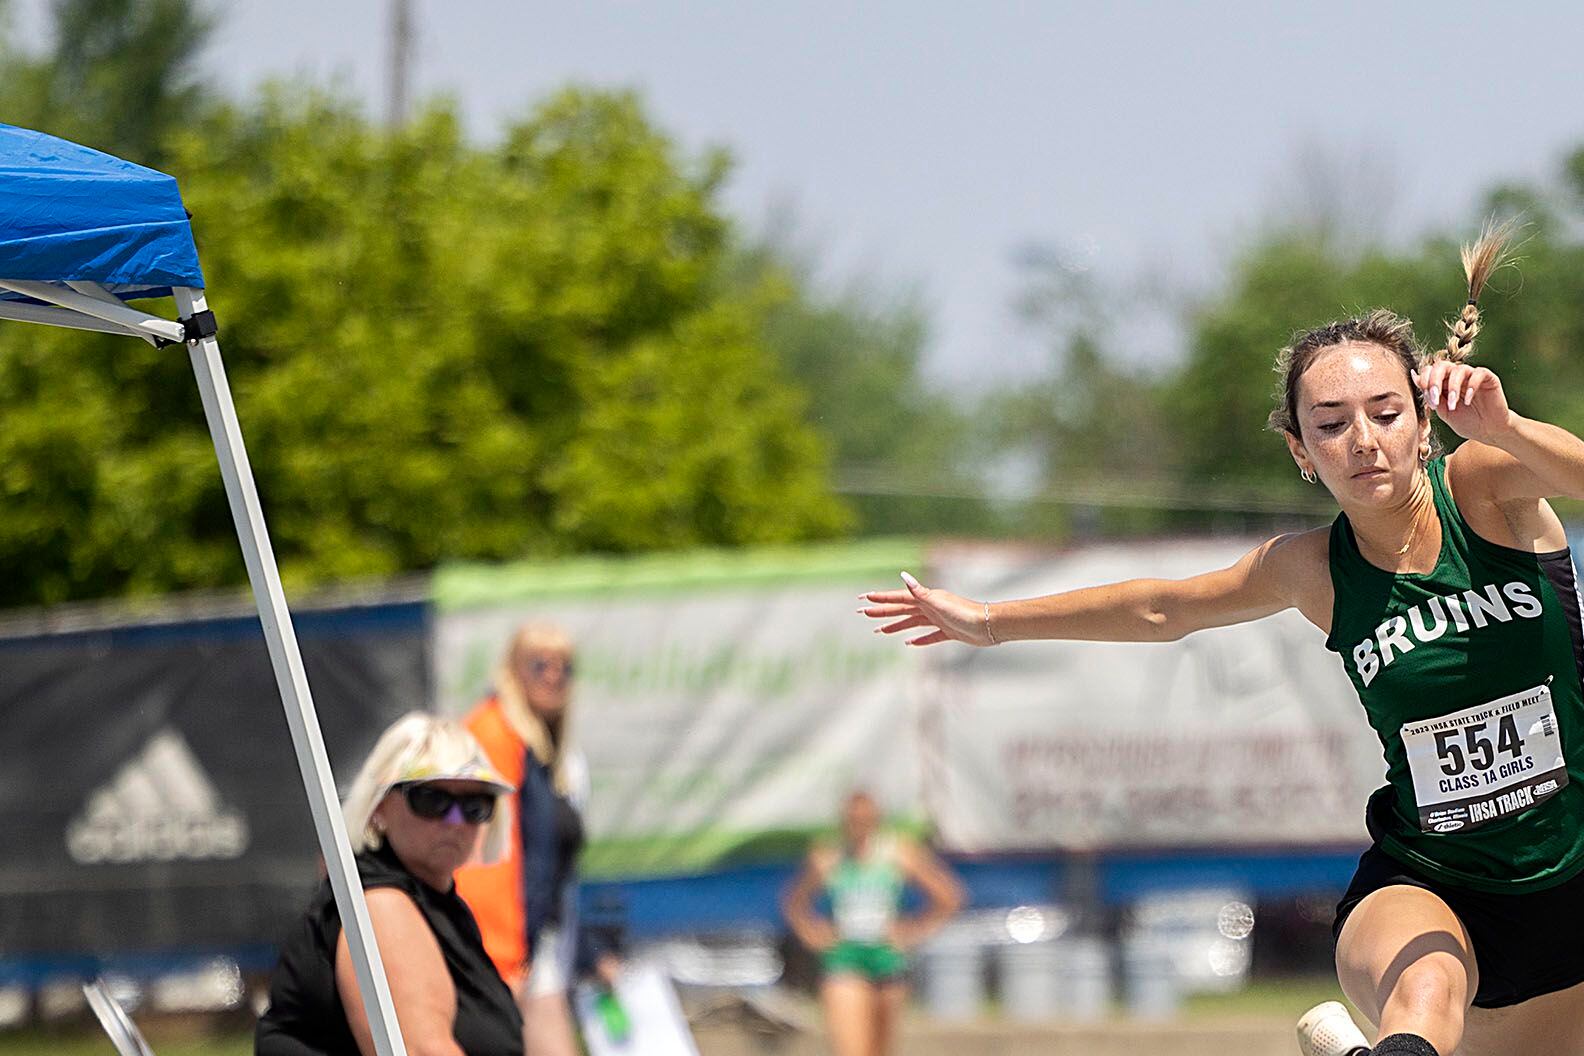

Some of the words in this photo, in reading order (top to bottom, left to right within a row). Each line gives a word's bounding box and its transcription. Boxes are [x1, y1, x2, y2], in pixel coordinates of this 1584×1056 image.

[1353, 581, 1543, 688] BRUINS
[1411, 726, 1430, 735] 2023
[1450, 716, 1470, 727] STATE
[1471, 709, 1494, 722] TRACK
[1501, 702, 1520, 714] FIELD
[1521, 695, 1540, 707] MEET
[1433, 714, 1525, 776] 554
[1439, 774, 1480, 793] CLASS
[1483, 769, 1498, 785] 1A
[1499, 756, 1534, 779] GIRLS
[1468, 799, 1498, 824] IHSA
[1495, 785, 1535, 815] TRACK
